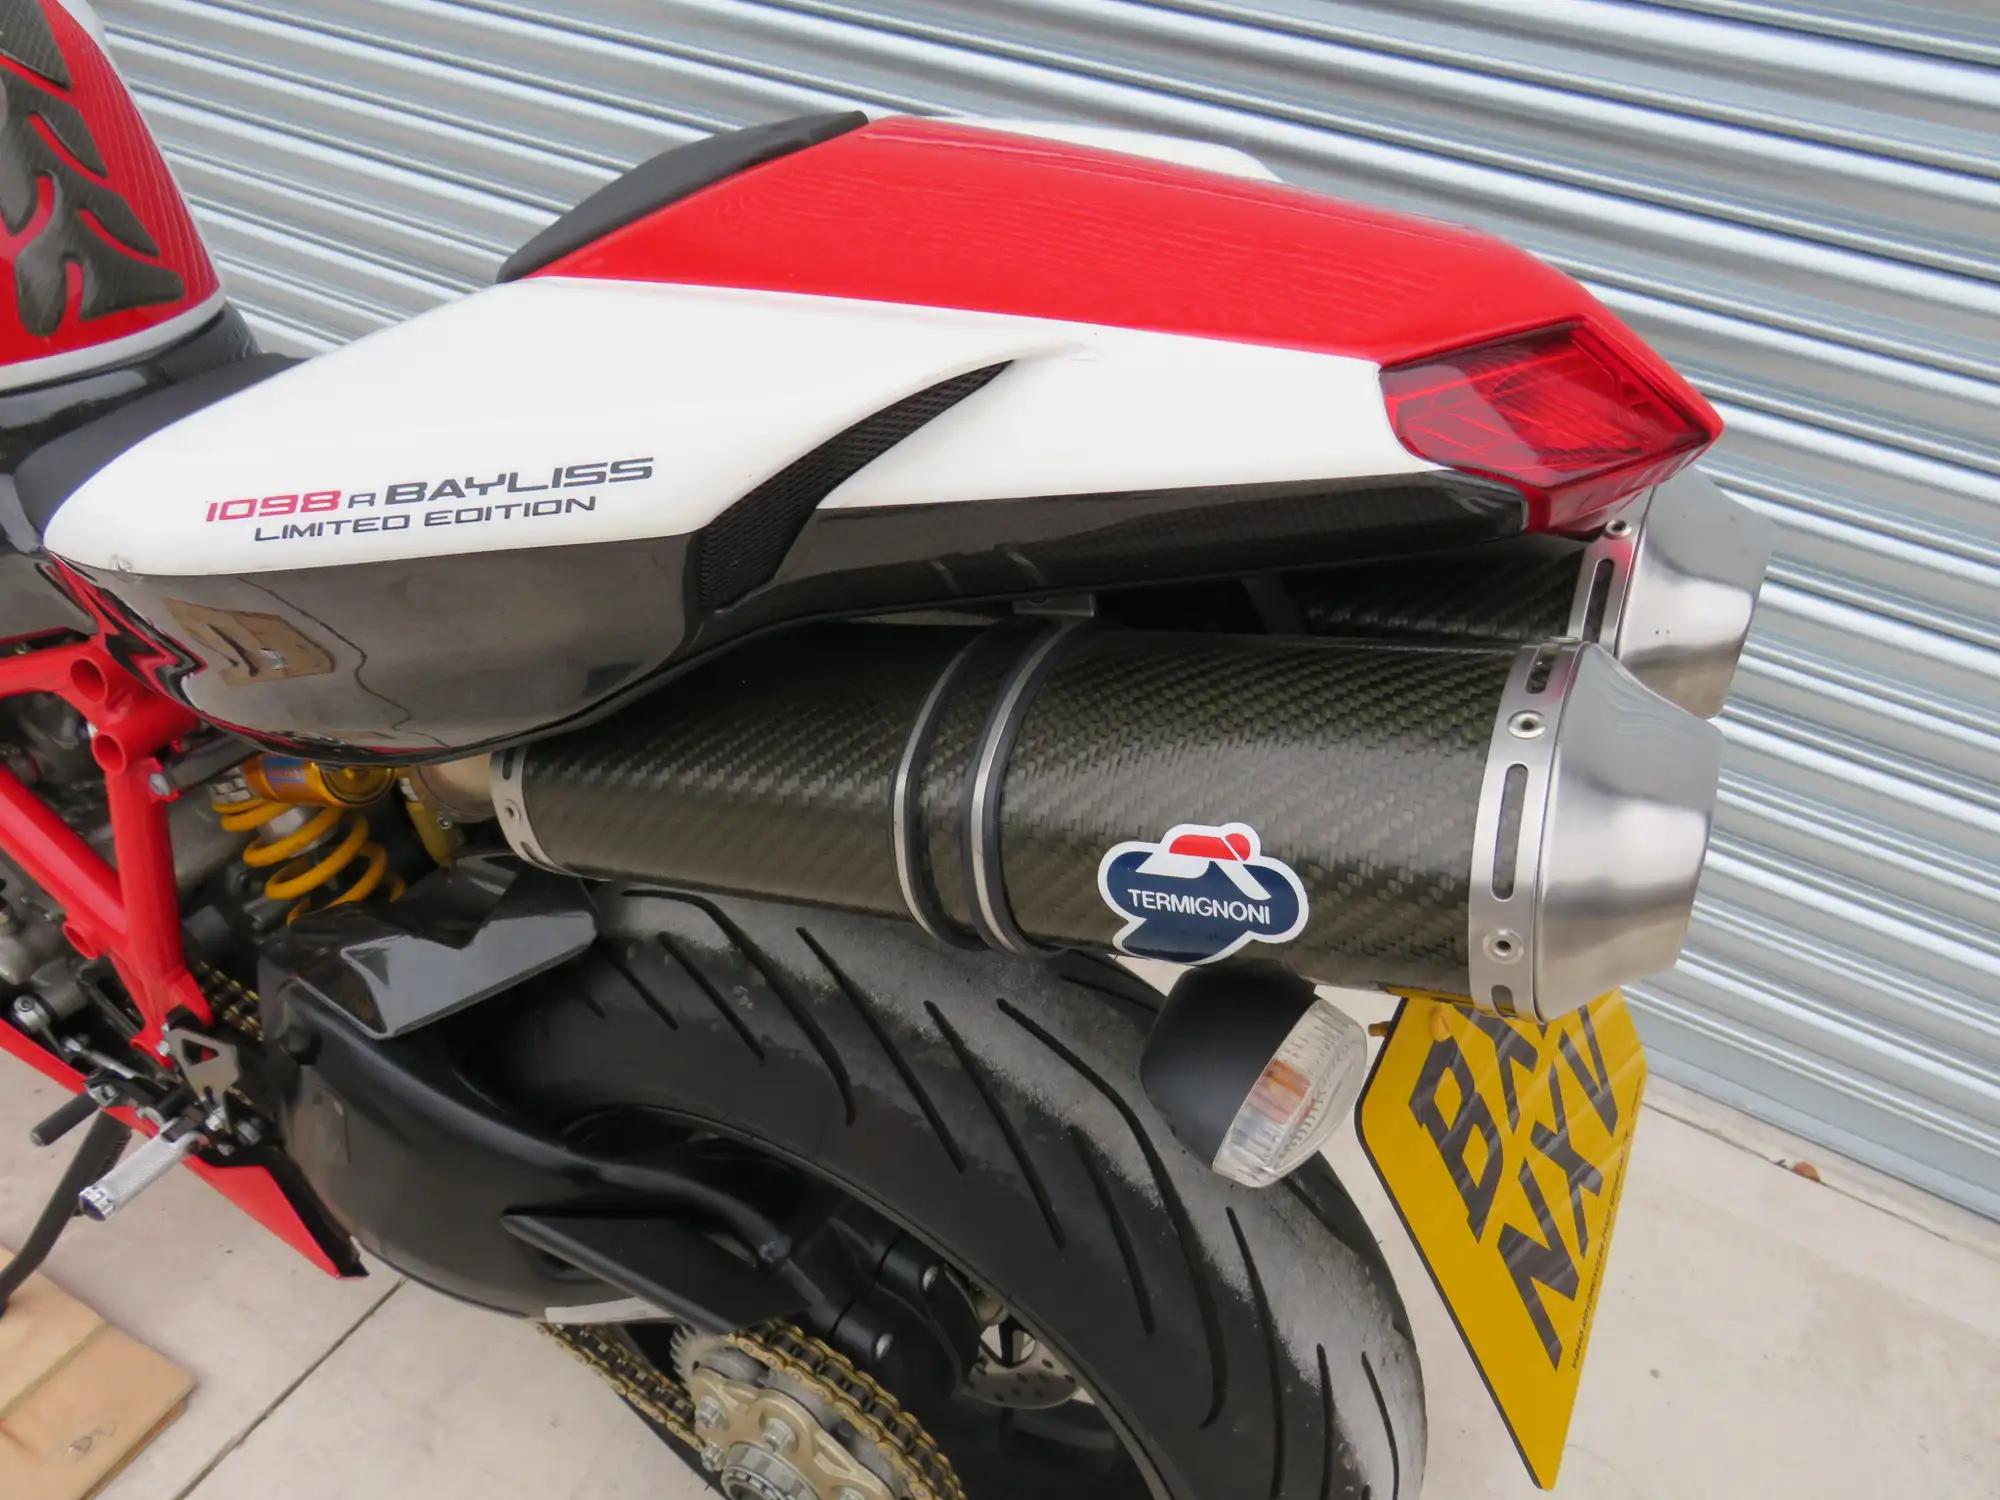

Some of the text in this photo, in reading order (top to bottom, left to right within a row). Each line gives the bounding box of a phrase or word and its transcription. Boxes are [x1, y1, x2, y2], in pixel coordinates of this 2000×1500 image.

[205, 490, 342, 523] 1098
[384, 456, 654, 506] BAYLISS
[254, 495, 597, 542] LIMITED EDITION
[1127, 888, 1271, 925] TERMIGNONI
[1409, 1003, 1548, 1243] BX
[1497, 1005, 1618, 1371] NXV
